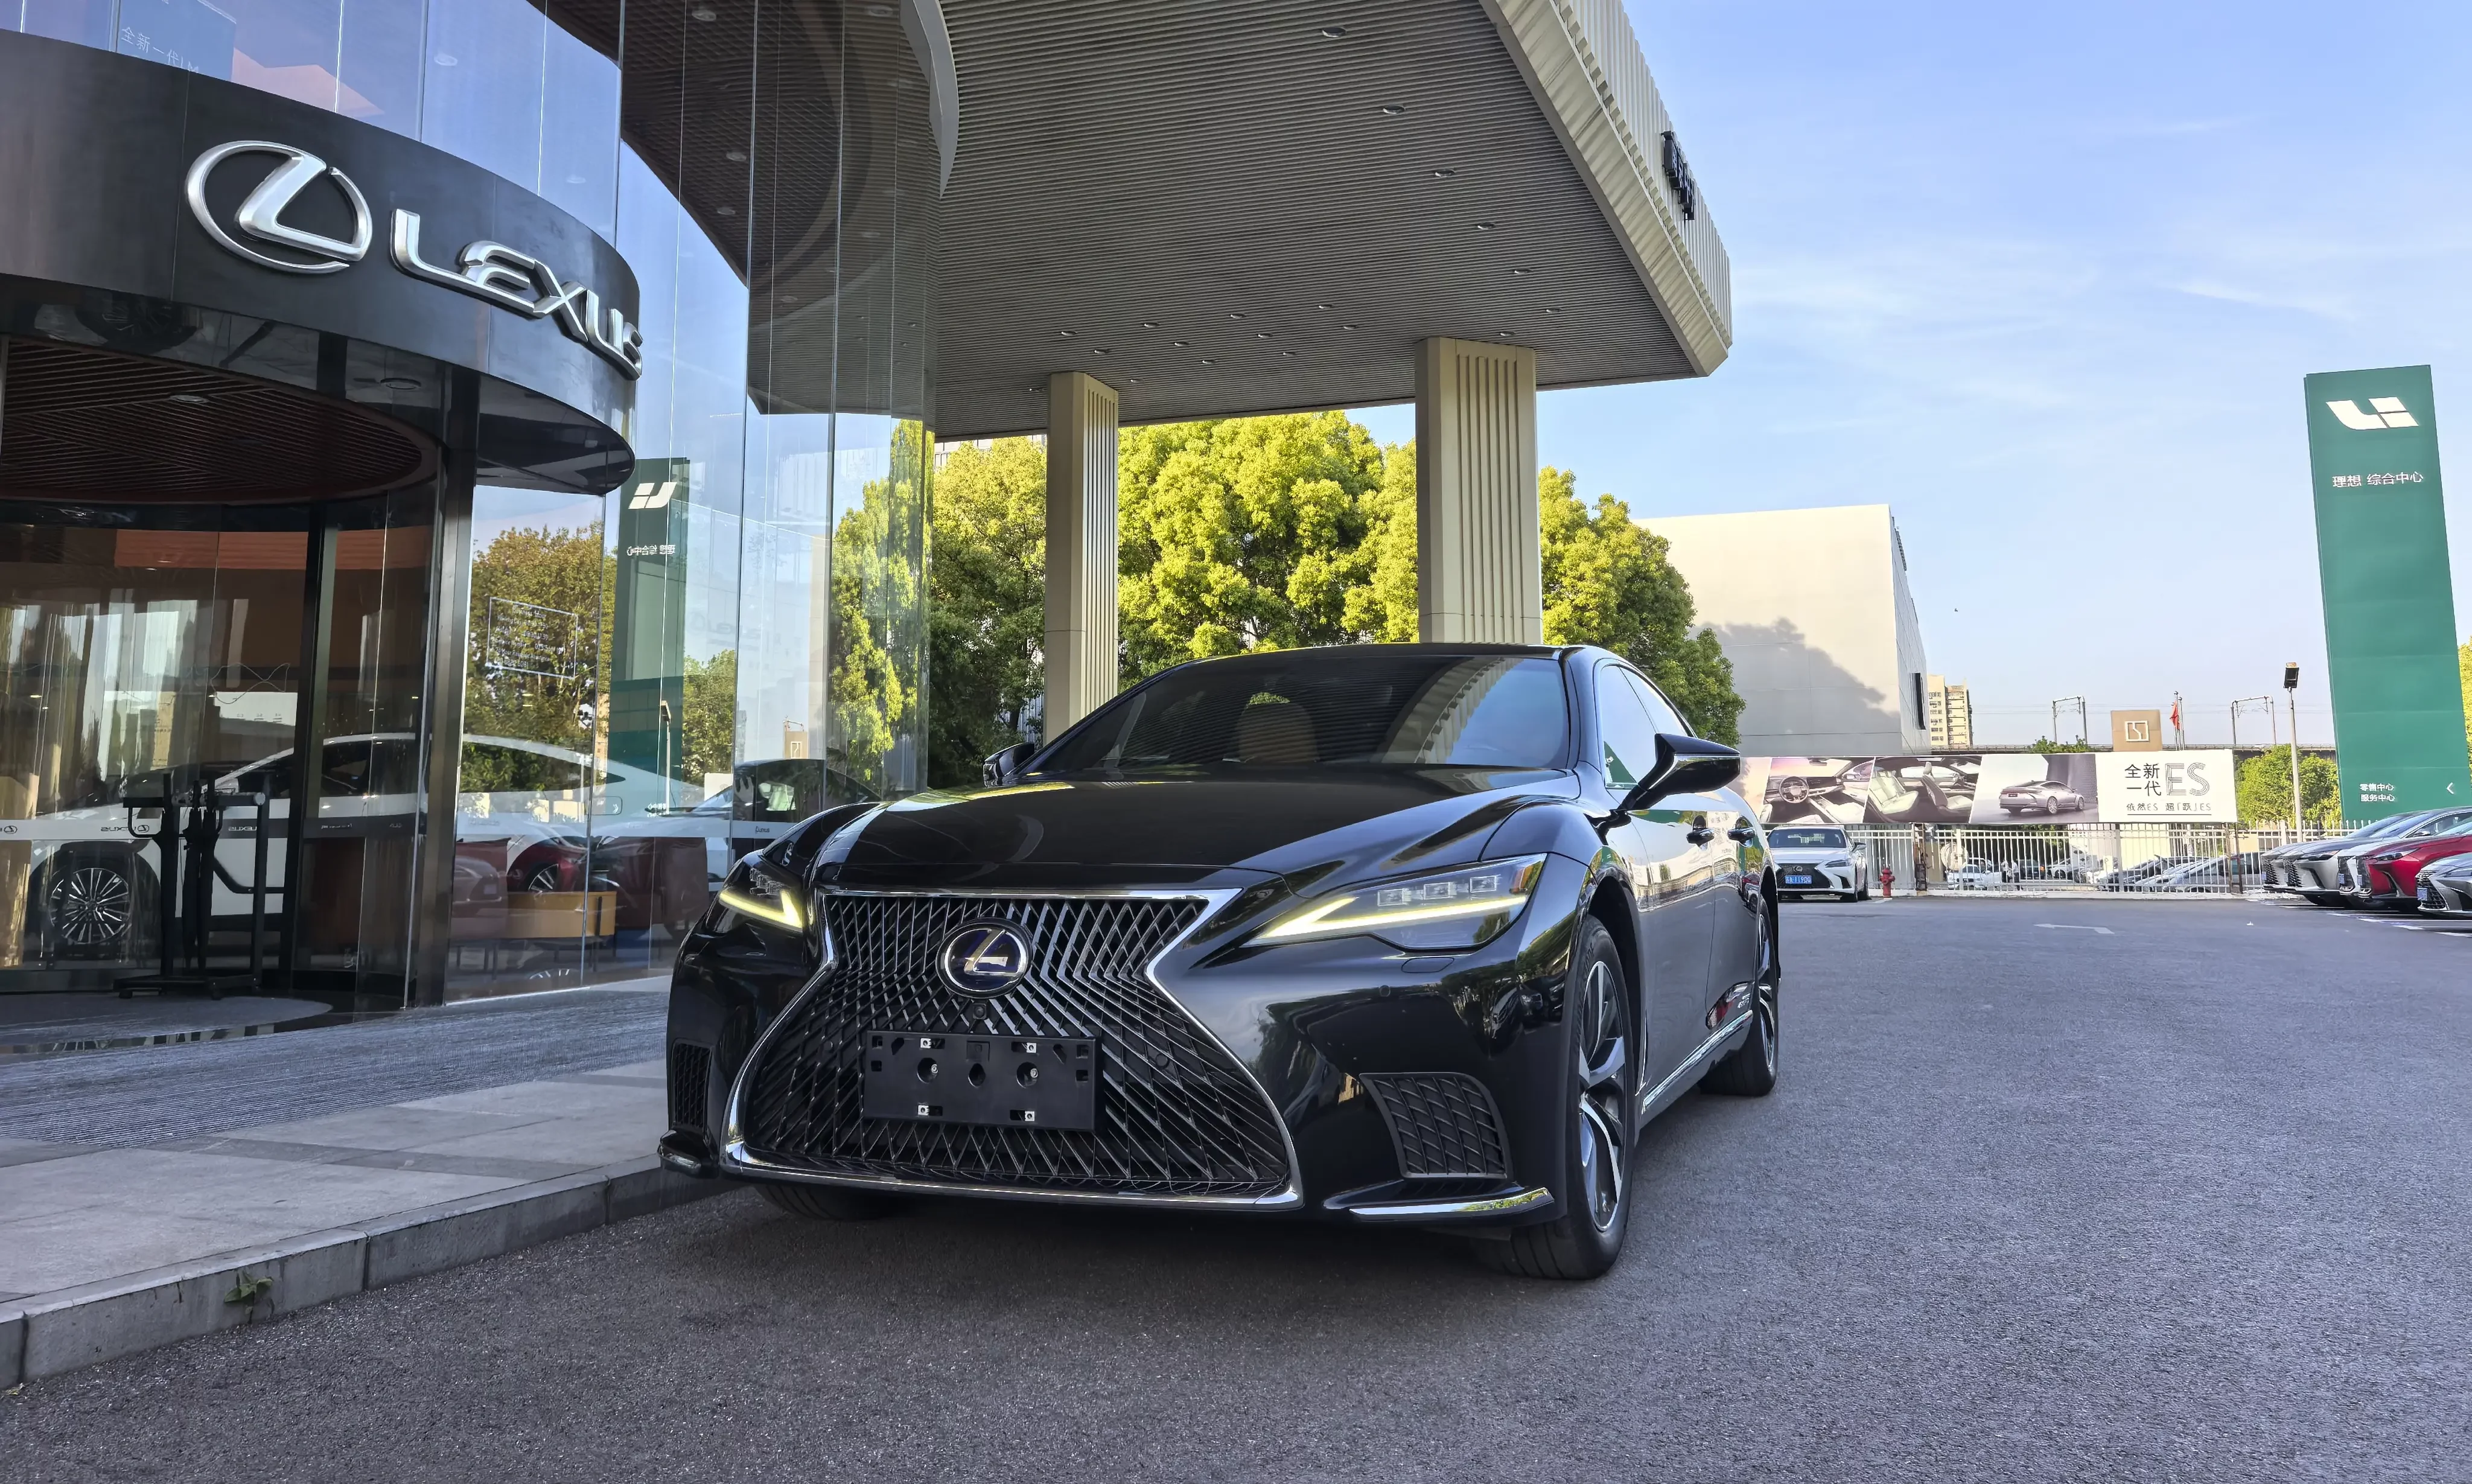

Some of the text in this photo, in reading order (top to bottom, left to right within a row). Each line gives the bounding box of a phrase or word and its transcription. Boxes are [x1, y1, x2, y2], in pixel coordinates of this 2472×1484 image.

[390, 208, 643, 380] LEXUS
[2332, 471, 2424, 488] 理想 综合中心
[2124, 763, 2160, 779] 全新
[2165, 762, 2210, 796] ES
[2126, 780, 2162, 796] 一代
[2360, 794, 2395, 802] 服务中心
